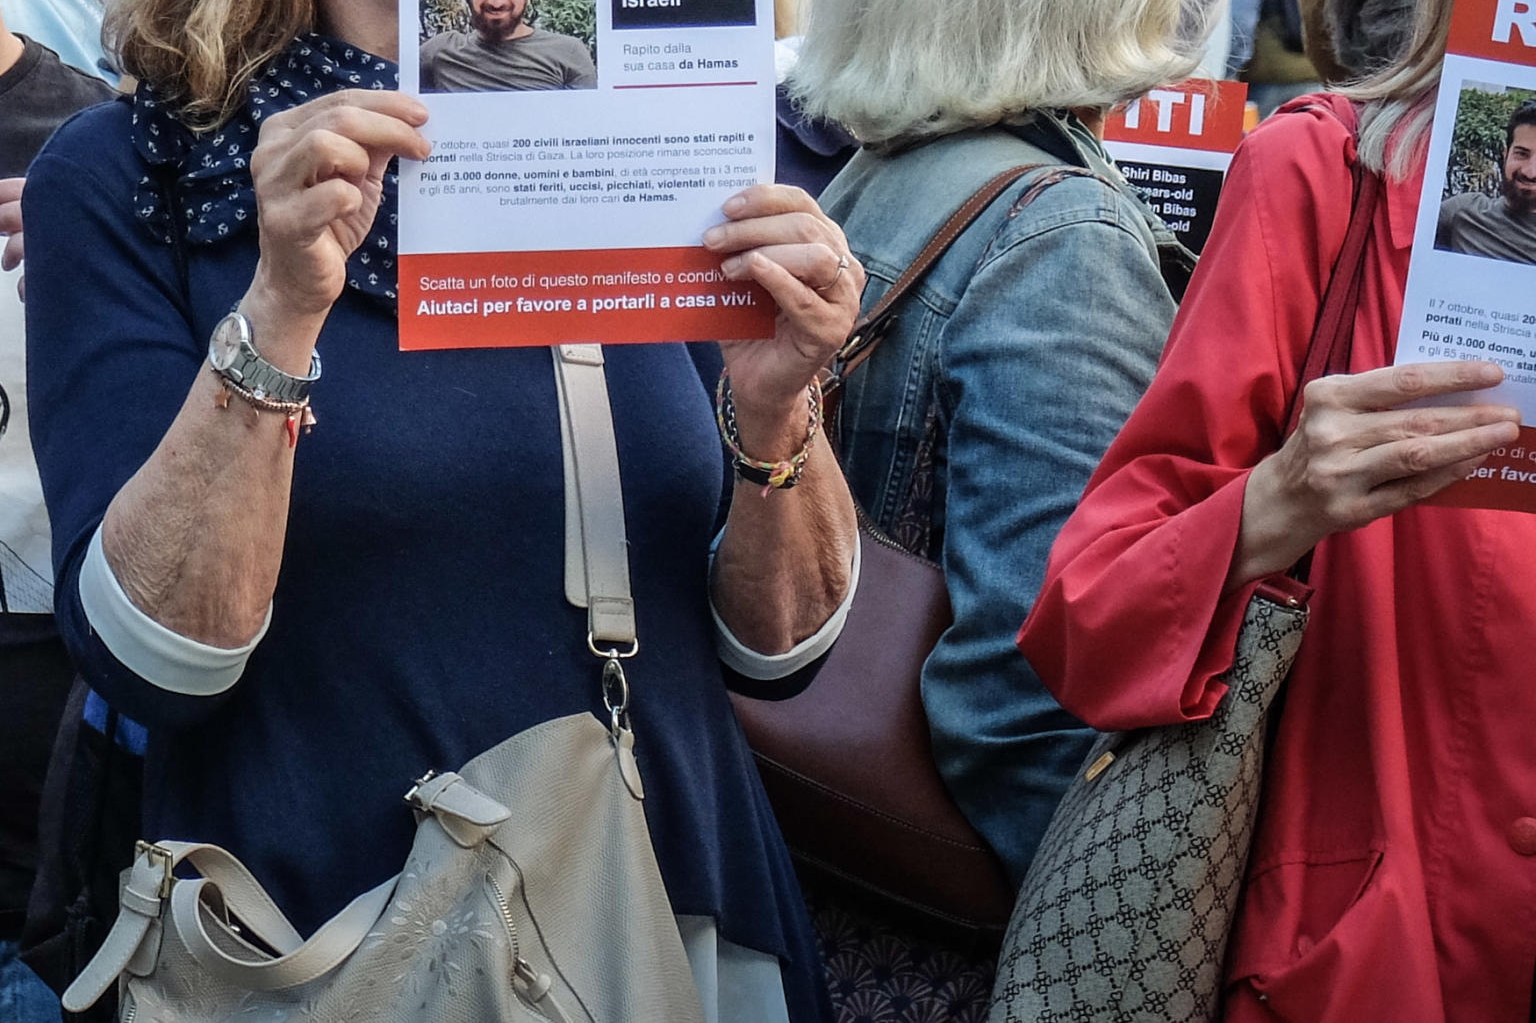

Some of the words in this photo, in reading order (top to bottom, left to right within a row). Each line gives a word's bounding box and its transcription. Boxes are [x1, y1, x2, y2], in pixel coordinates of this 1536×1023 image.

[623, 43, 660, 56] Rapito
[663, 42, 692, 54] dalla
[623, 62, 644, 72] sua
[647, 62, 675, 70] casa
[678, 59, 693, 70] da
[697, 58, 738, 69] Hamas
[1124, 89, 1206, 136] ITI
[1152, 169, 1185, 183] Bibas
[1162, 203, 1197, 218] Bibas
[419, 276, 465, 291] Scatta
[469, 277, 487, 289] un
[490, 274, 518, 288] foto
[521, 273, 535, 288] di
[539, 273, 588, 290] questo
[592, 271, 661, 285] manifesto
[664, 272, 674, 283] e
[677, 270, 726, 285] condiv
[416, 298, 478, 315] Aiutaci
[483, 300, 513, 317] per
[516, 296, 572, 312] favore
[576, 298, 587, 310] a
[592, 293, 655, 314] portarli
[659, 296, 670, 308] a
[674, 295, 716, 308] casa
[720, 291, 755, 306] vivi.
[1425, 313, 1462, 326] portati
[1421, 330, 1440, 341] Più
[1442, 334, 1453, 344] di
[1456, 336, 1485, 349] 3.000
[1487, 342, 1526, 357] donne,
